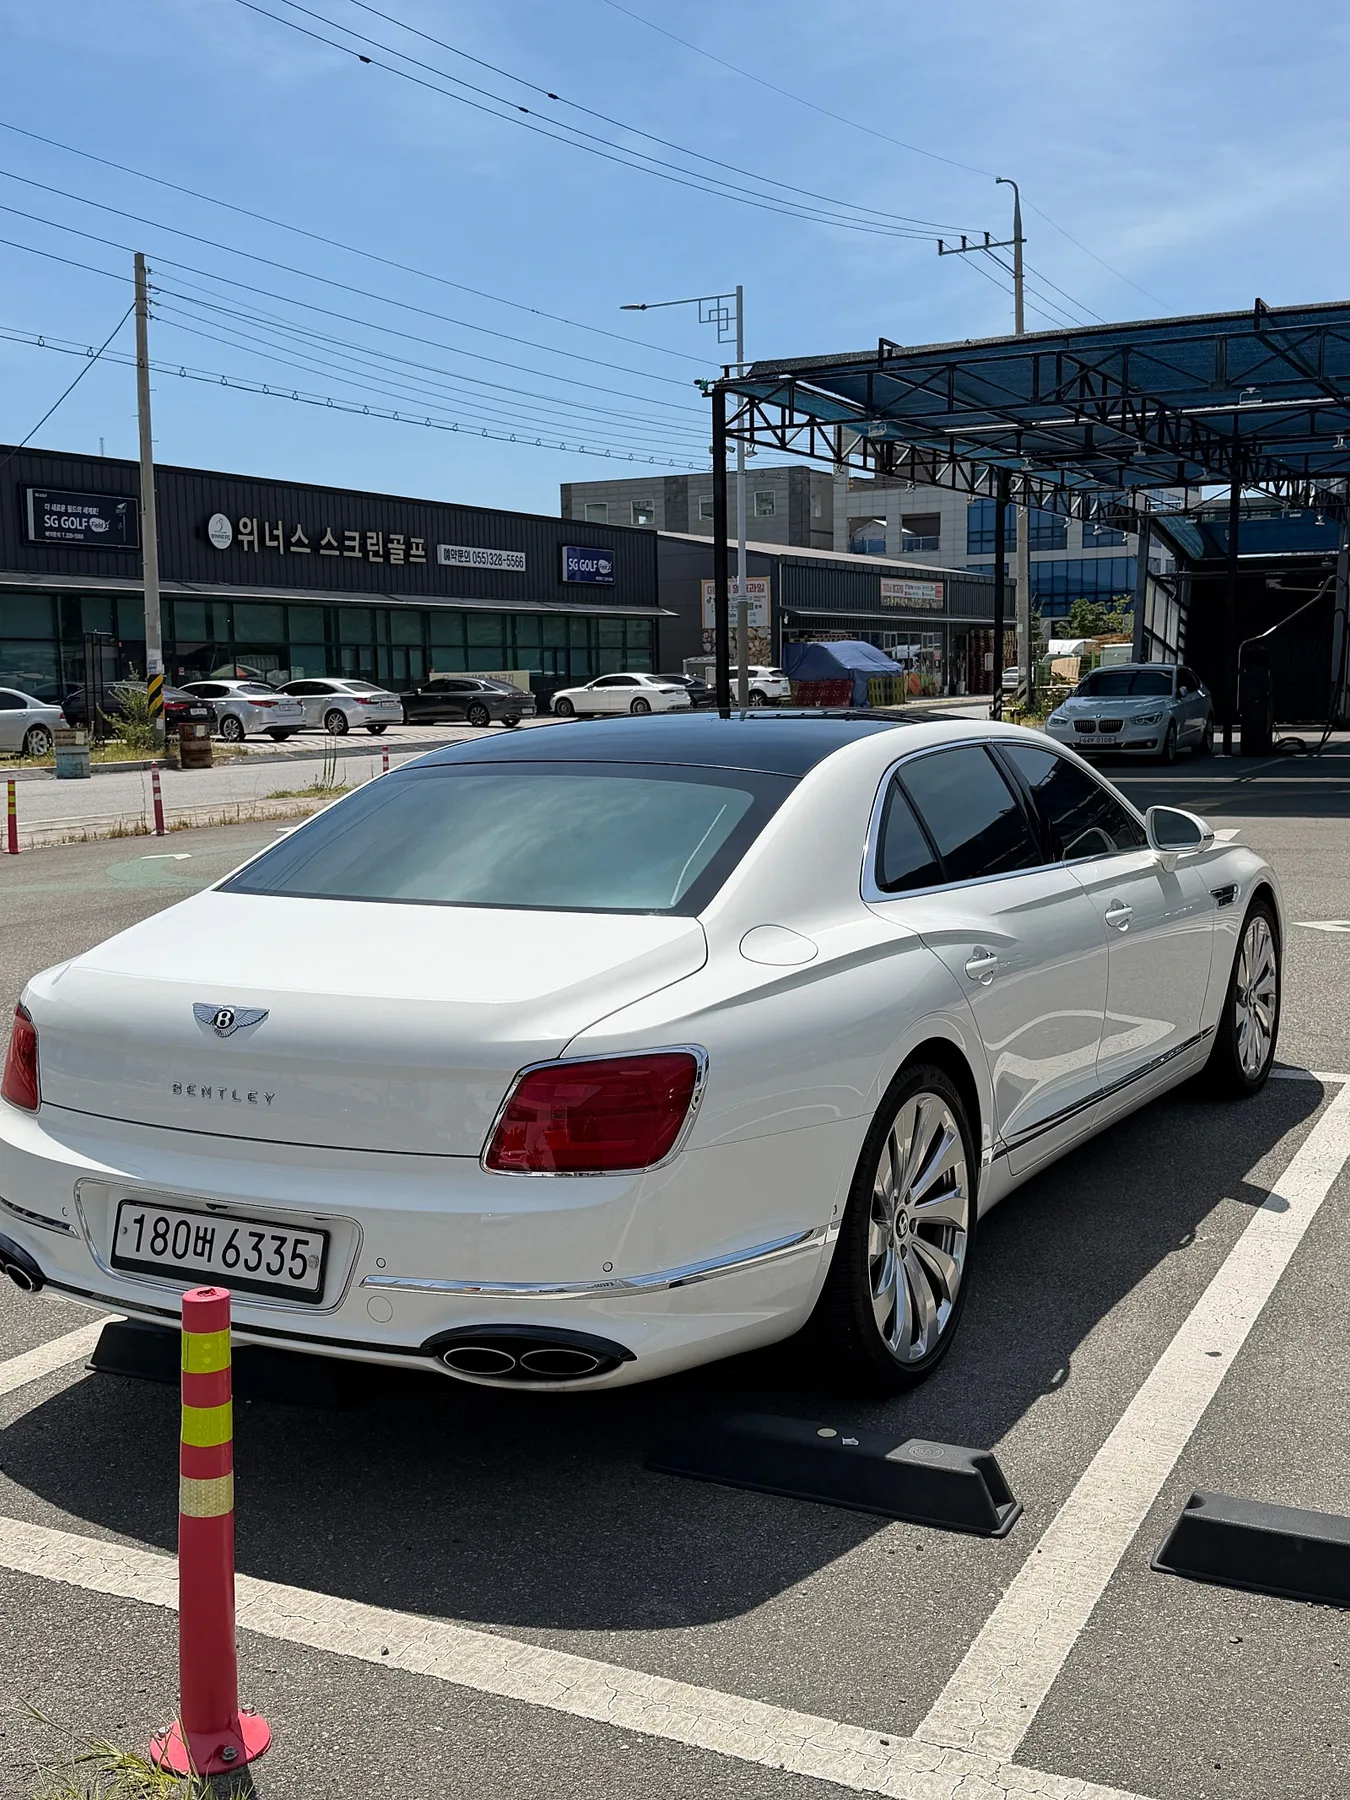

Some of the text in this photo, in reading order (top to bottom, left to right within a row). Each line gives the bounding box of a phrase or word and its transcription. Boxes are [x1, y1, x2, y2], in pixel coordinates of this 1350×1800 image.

[44, 515, 58, 527] SG
[61, 517, 88, 530] GOLF
[237, 517, 427, 565] 위너스 스크린골프
[443, 547, 524, 569] 예약문의 055)328-5566
[568, 558, 598, 572] SG GOLF
[172, 1081, 276, 1106] BENTLEY
[133, 1213, 310, 1280] 180버 6335
